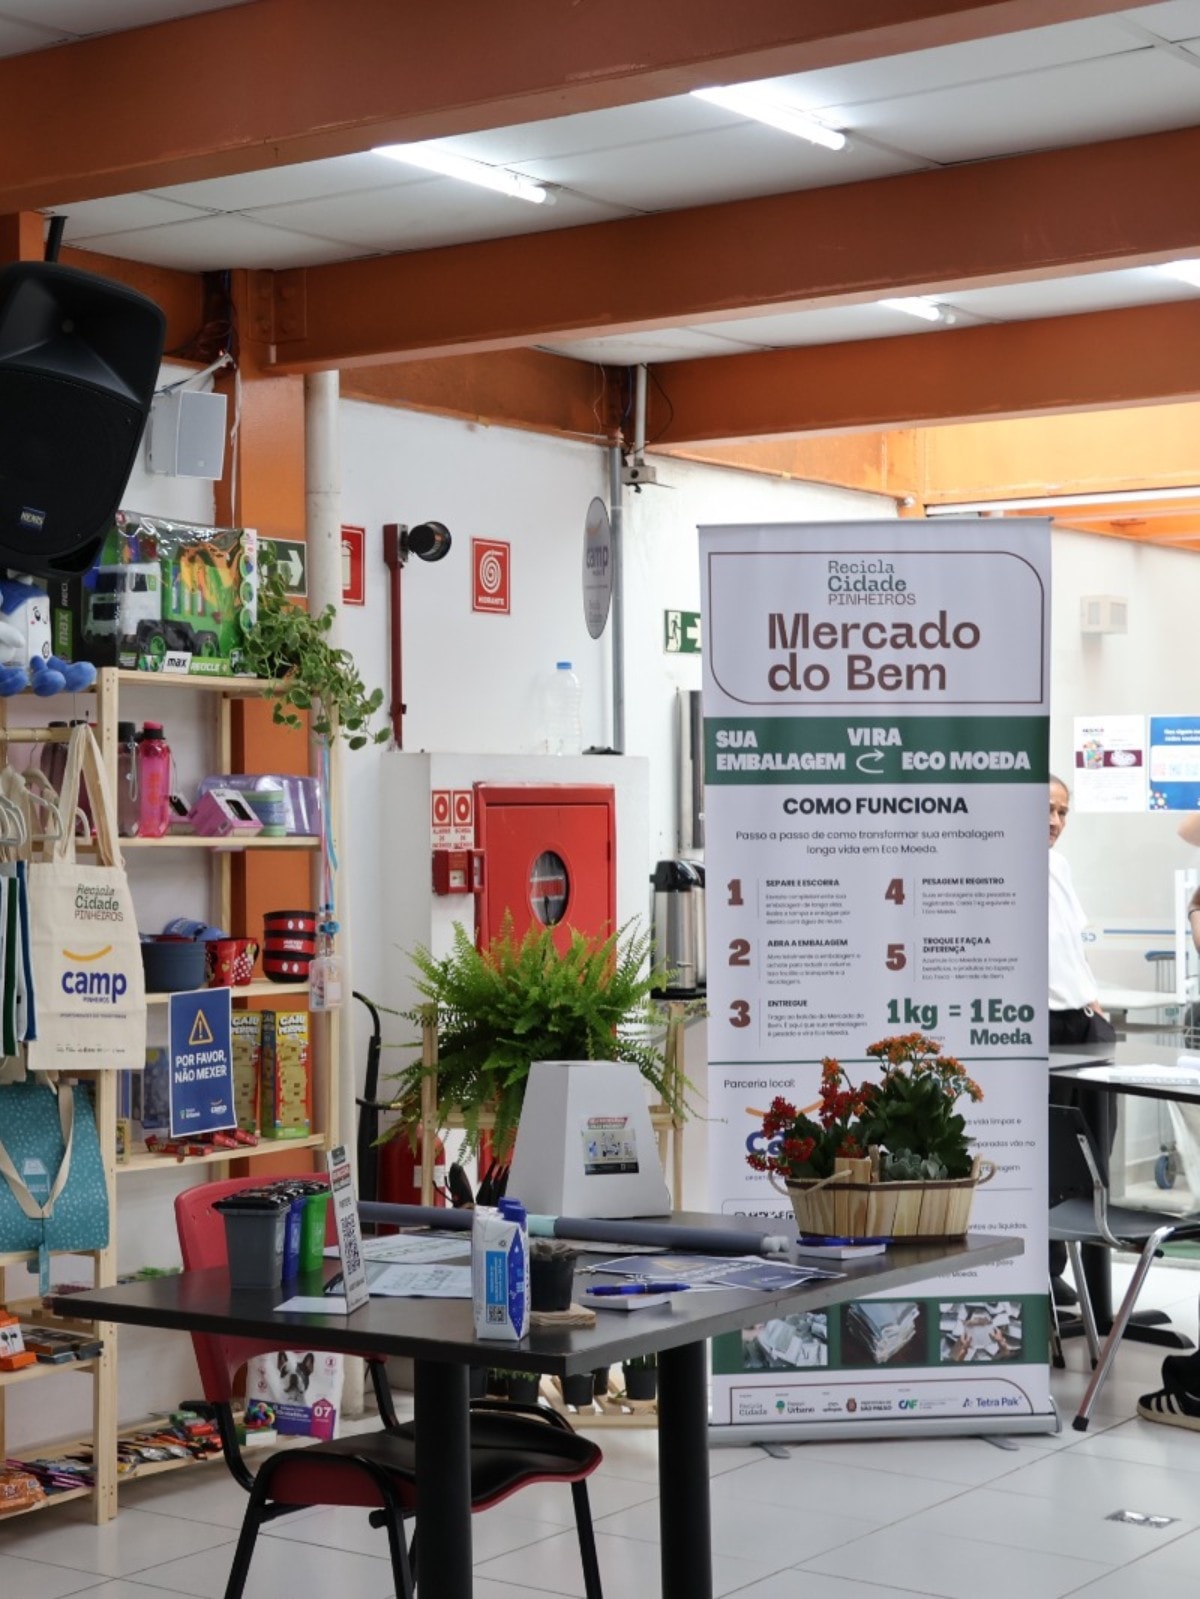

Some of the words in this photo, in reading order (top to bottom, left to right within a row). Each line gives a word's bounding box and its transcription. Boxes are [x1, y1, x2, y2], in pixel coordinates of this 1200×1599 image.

[828, 560, 894, 575] Recicla
[828, 575, 907, 593] Cidade
[828, 593, 917, 606] PINHEIROS
[59, 612, 68, 645] max
[767, 610, 981, 650] Mercado
[167, 658, 187, 668] max
[767, 652, 830, 692] do
[846, 655, 947, 692] Bem
[716, 730, 758, 749] SUA
[847, 727, 902, 747] VIRA
[716, 752, 846, 771] EMBALAGEM
[902, 751, 946, 771] ECO
[949, 751, 1031, 771] MOEDA
[783, 797, 851, 815] COMO
[856, 797, 968, 814] FUNCIONA
[736, 830, 766, 841] Passo
[769, 832, 777, 841] a
[779, 832, 810, 844] passo
[811, 830, 824, 841] de
[827, 831, 856, 841] como
[859, 829, 919, 841] transformar
[921, 831, 939, 840] sua
[941, 828, 1004, 842] embalagem
[806, 844, 836, 857] longa
[838, 844, 860, 855] vida
[862, 846, 879, 855] em
[881, 844, 898, 855] Eco
[766, 879, 795, 888] SEPARE
[965, 877, 1004, 885] REGISTRO
[77, 883, 115, 897] Recicla
[727, 878, 744, 906] 1
[884, 878, 905, 905] 4
[74, 895, 119, 911] Cidade
[74, 910, 124, 921] PINHEIROS
[767, 939, 790, 947] ABRA
[798, 939, 848, 947] EMBALAGEM
[923, 937, 954, 945] TROQUE
[728, 938, 751, 966] 2
[885, 943, 907, 971] 5
[61, 970, 127, 1003] camp
[729, 1000, 751, 1029] 3
[949, 1005, 961, 1017] =
[970, 1028, 1032, 1045] Moeda
[175, 1053, 195, 1068] POR
[196, 1050, 227, 1066] FAVOR,
[175, 1069, 195, 1083] NÃO
[196, 1065, 227, 1080] MEXER
[724, 1079, 767, 1089] Parceria
[976, 1397, 1000, 1408] Tetra
[314, 1406, 331, 1418] 07
